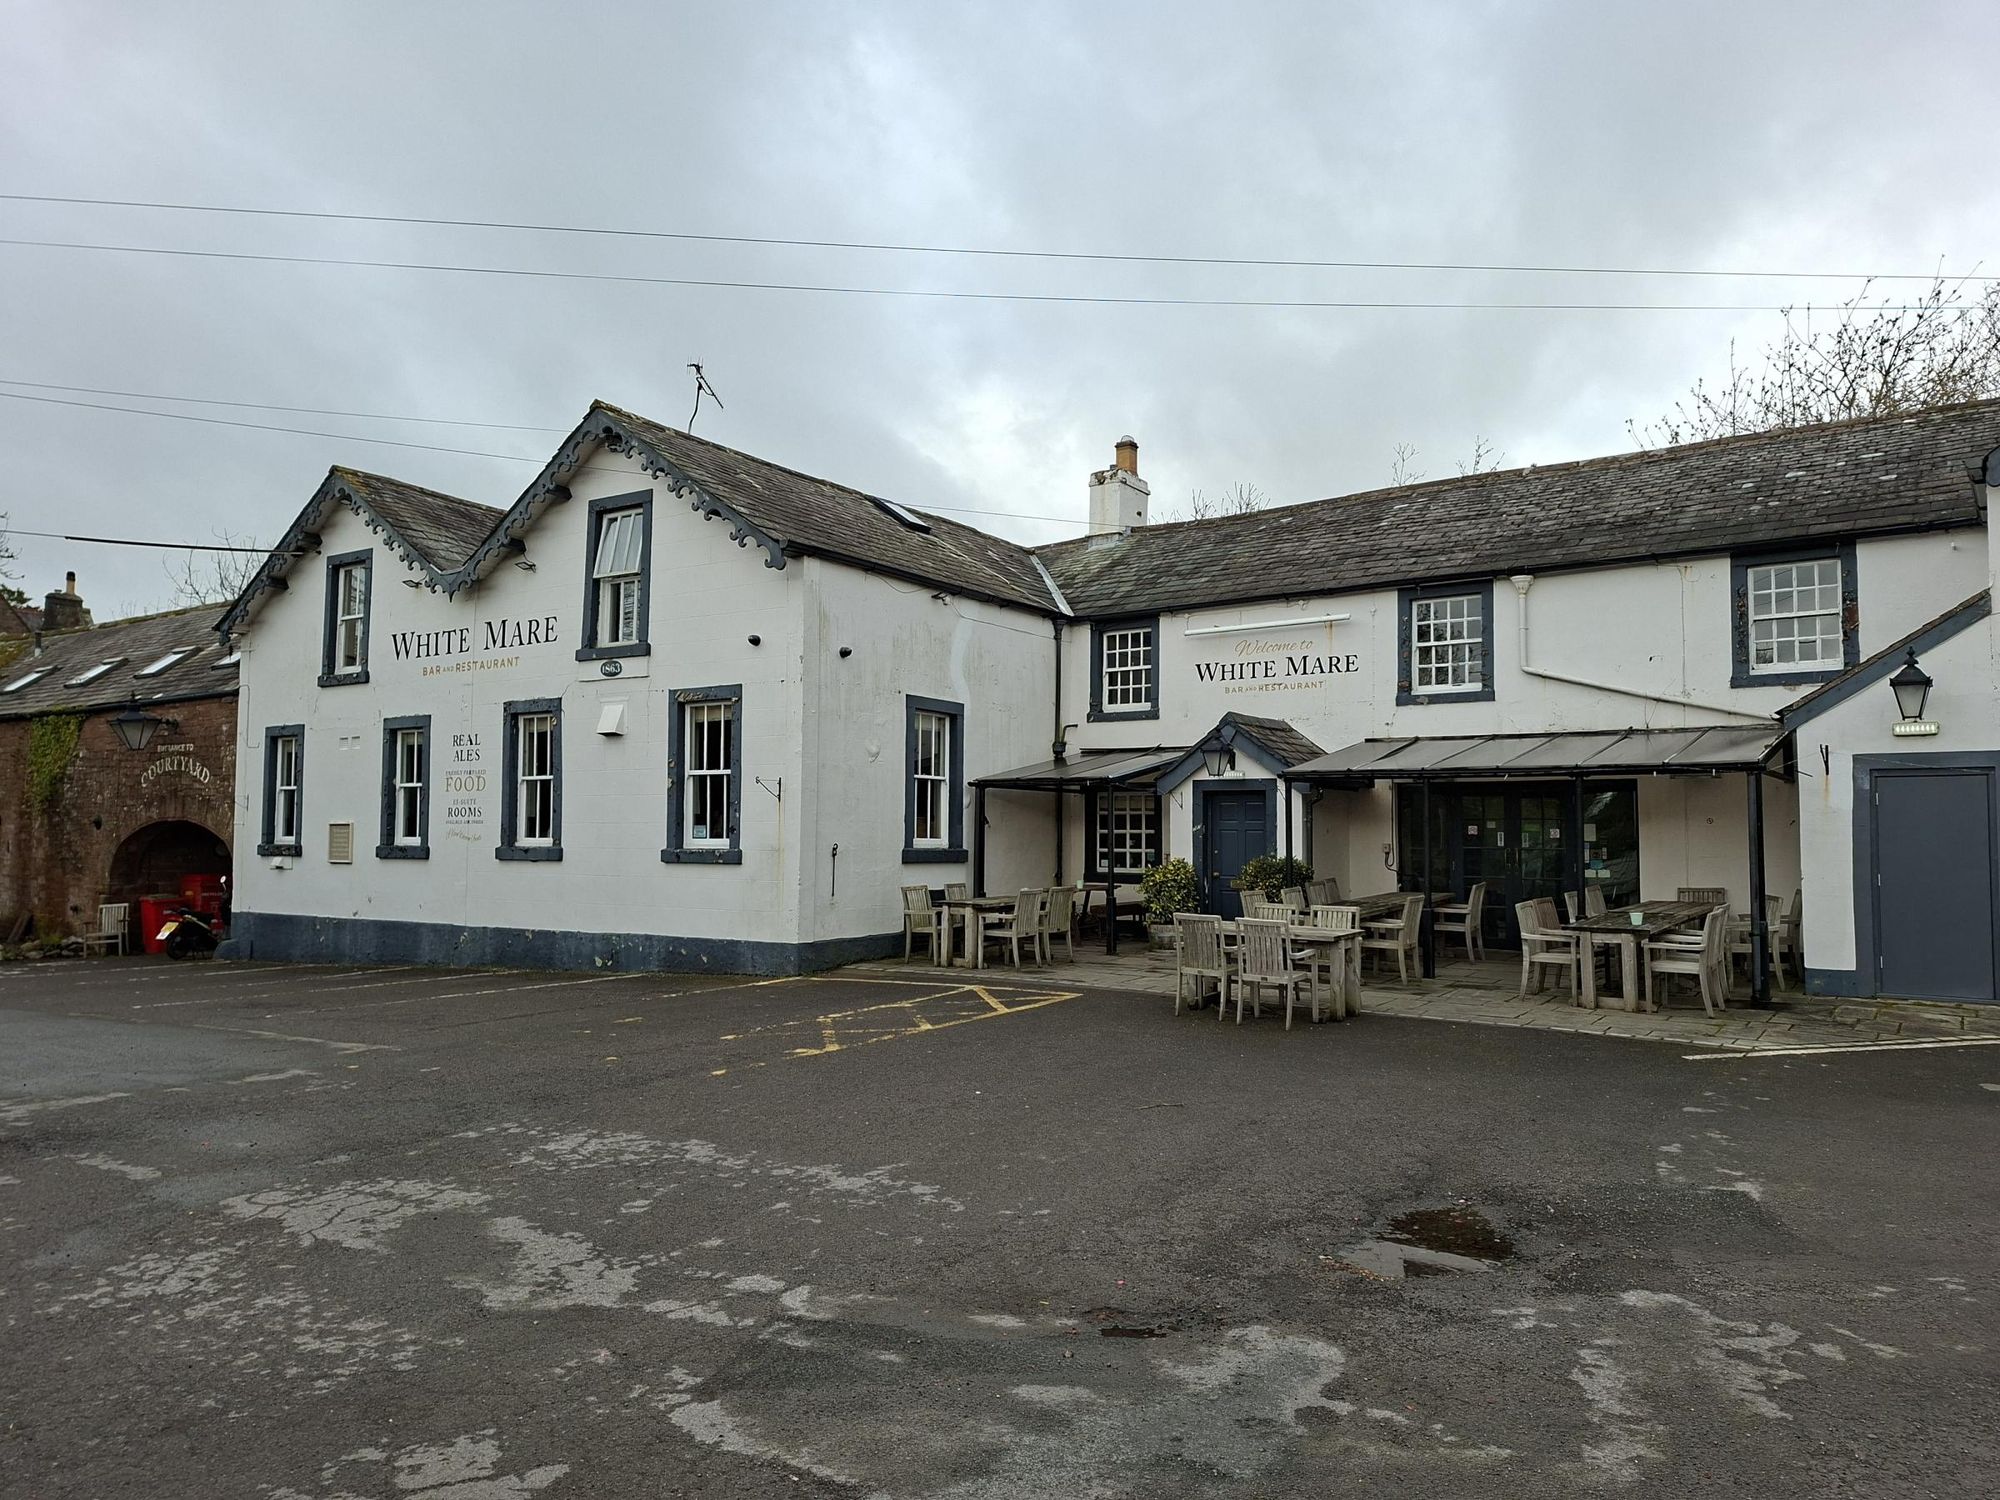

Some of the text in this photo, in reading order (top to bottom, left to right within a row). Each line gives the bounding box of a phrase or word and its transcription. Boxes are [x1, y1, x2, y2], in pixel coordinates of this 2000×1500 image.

[391, 616, 558, 660] WHITE MARE
[1234, 639, 1313, 657] Welcome to
[422, 665, 441, 676] BAR
[455, 656, 520, 673] RESTAURANT
[602, 663, 620, 673] 1863
[1195, 654, 1359, 682] WHITE MARE
[1225, 686, 1243, 695] BAR
[1258, 681, 1324, 693] RESTAURANT
[453, 733, 481, 747] REAL
[453, 749, 481, 762] ALES
[141, 755, 210, 787] COURTYARD
[445, 776, 486, 792] FOOD
[448, 807, 481, 818] ROOMS
